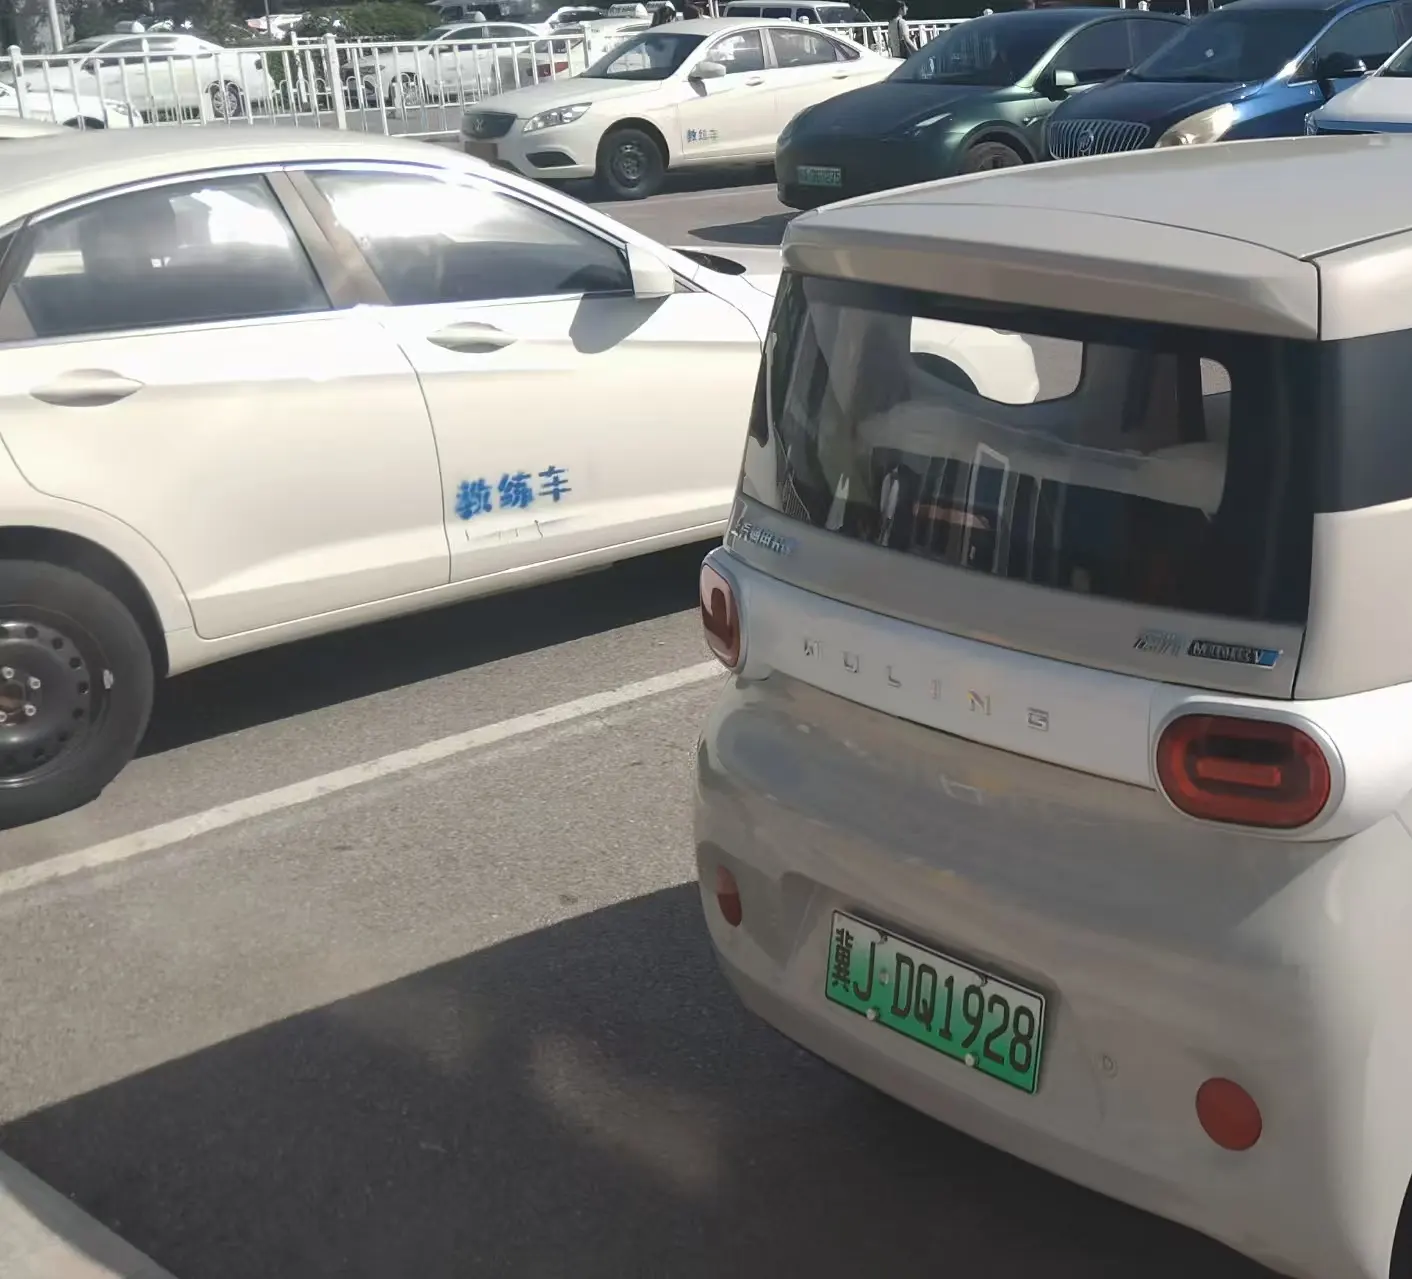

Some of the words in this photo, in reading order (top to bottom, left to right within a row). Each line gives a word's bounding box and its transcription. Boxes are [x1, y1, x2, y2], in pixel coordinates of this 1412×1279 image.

[456, 465, 572, 520] 教练车
[803, 637, 1050, 732] WULING
